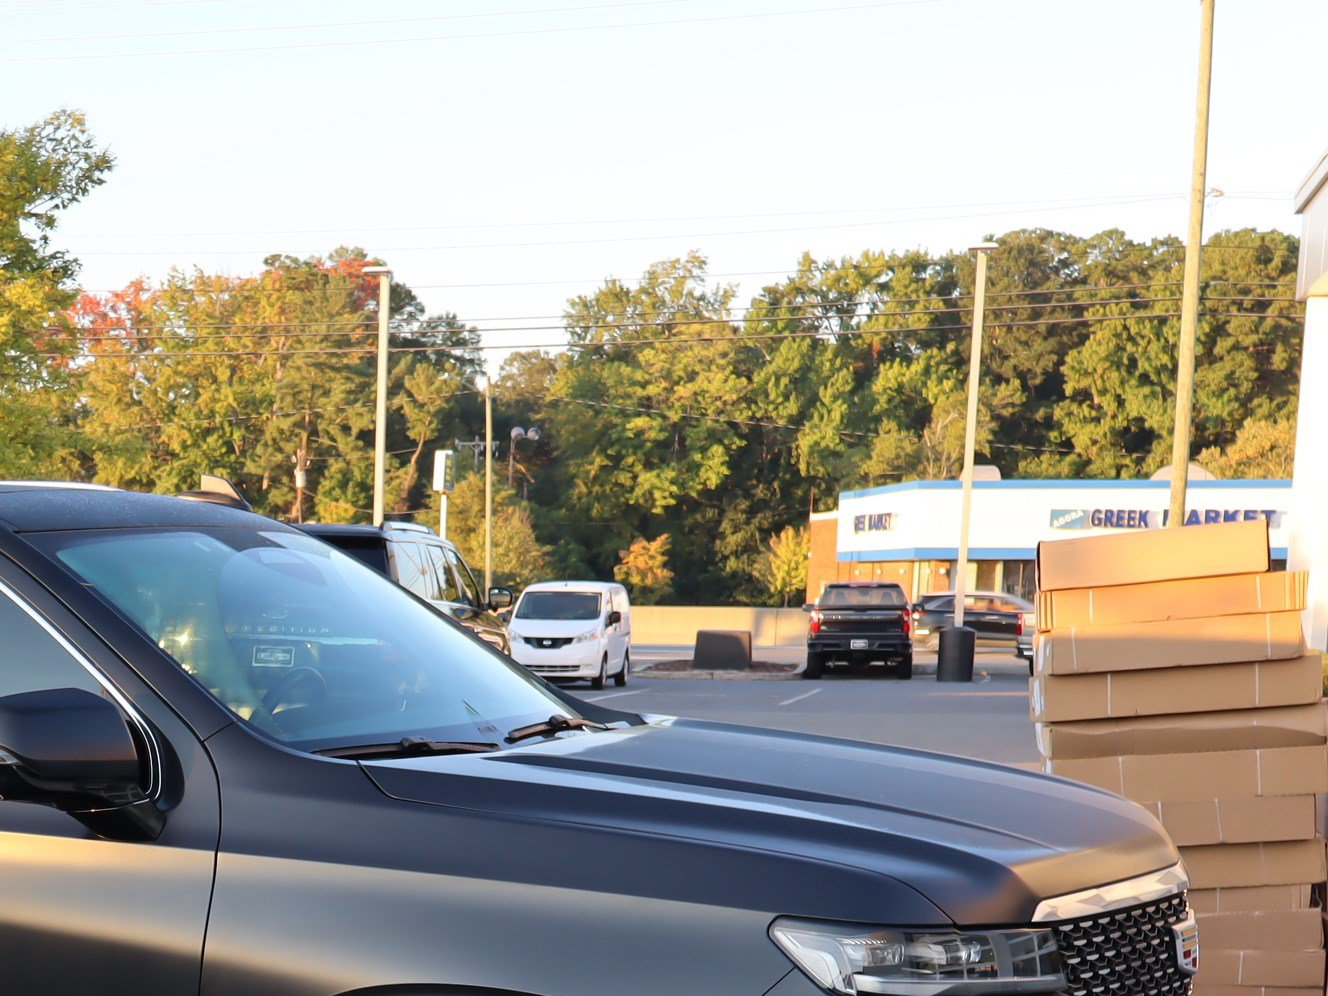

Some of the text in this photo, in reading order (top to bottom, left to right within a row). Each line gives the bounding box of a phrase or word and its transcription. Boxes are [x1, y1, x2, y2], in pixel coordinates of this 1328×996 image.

[1053, 509, 1084, 528] AGORA
[1091, 508, 1277, 528] GREEK ARKET
